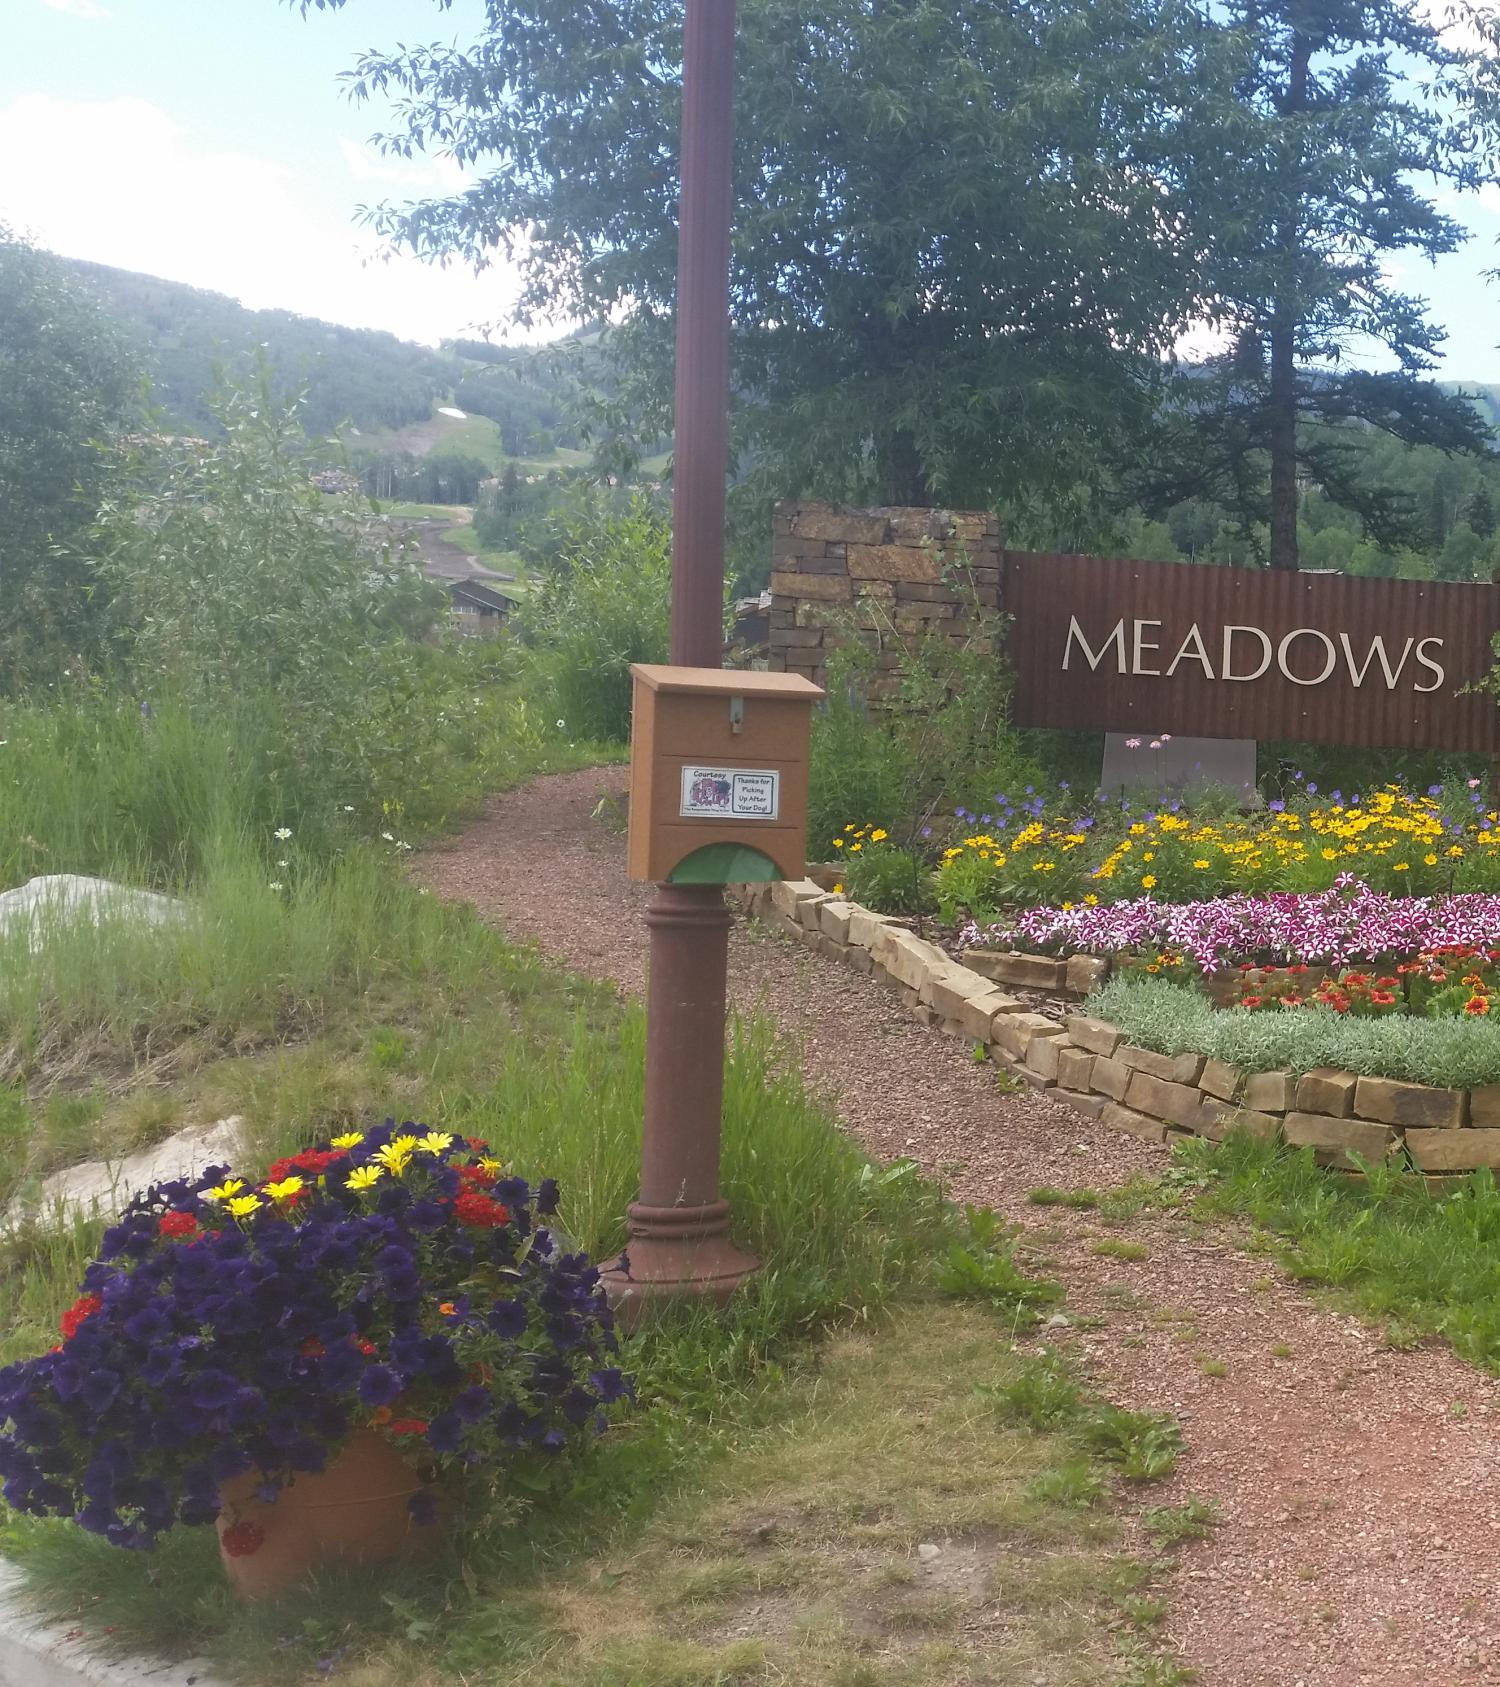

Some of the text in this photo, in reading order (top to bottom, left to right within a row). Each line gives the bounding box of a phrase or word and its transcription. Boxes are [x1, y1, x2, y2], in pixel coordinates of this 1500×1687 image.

[1061, 614, 1445, 692] MEADOWS
[693, 770, 727, 779] Courtesy
[742, 786, 764, 794] Picking
[739, 795, 748, 803] Up
[753, 804, 768, 812] Dog!
